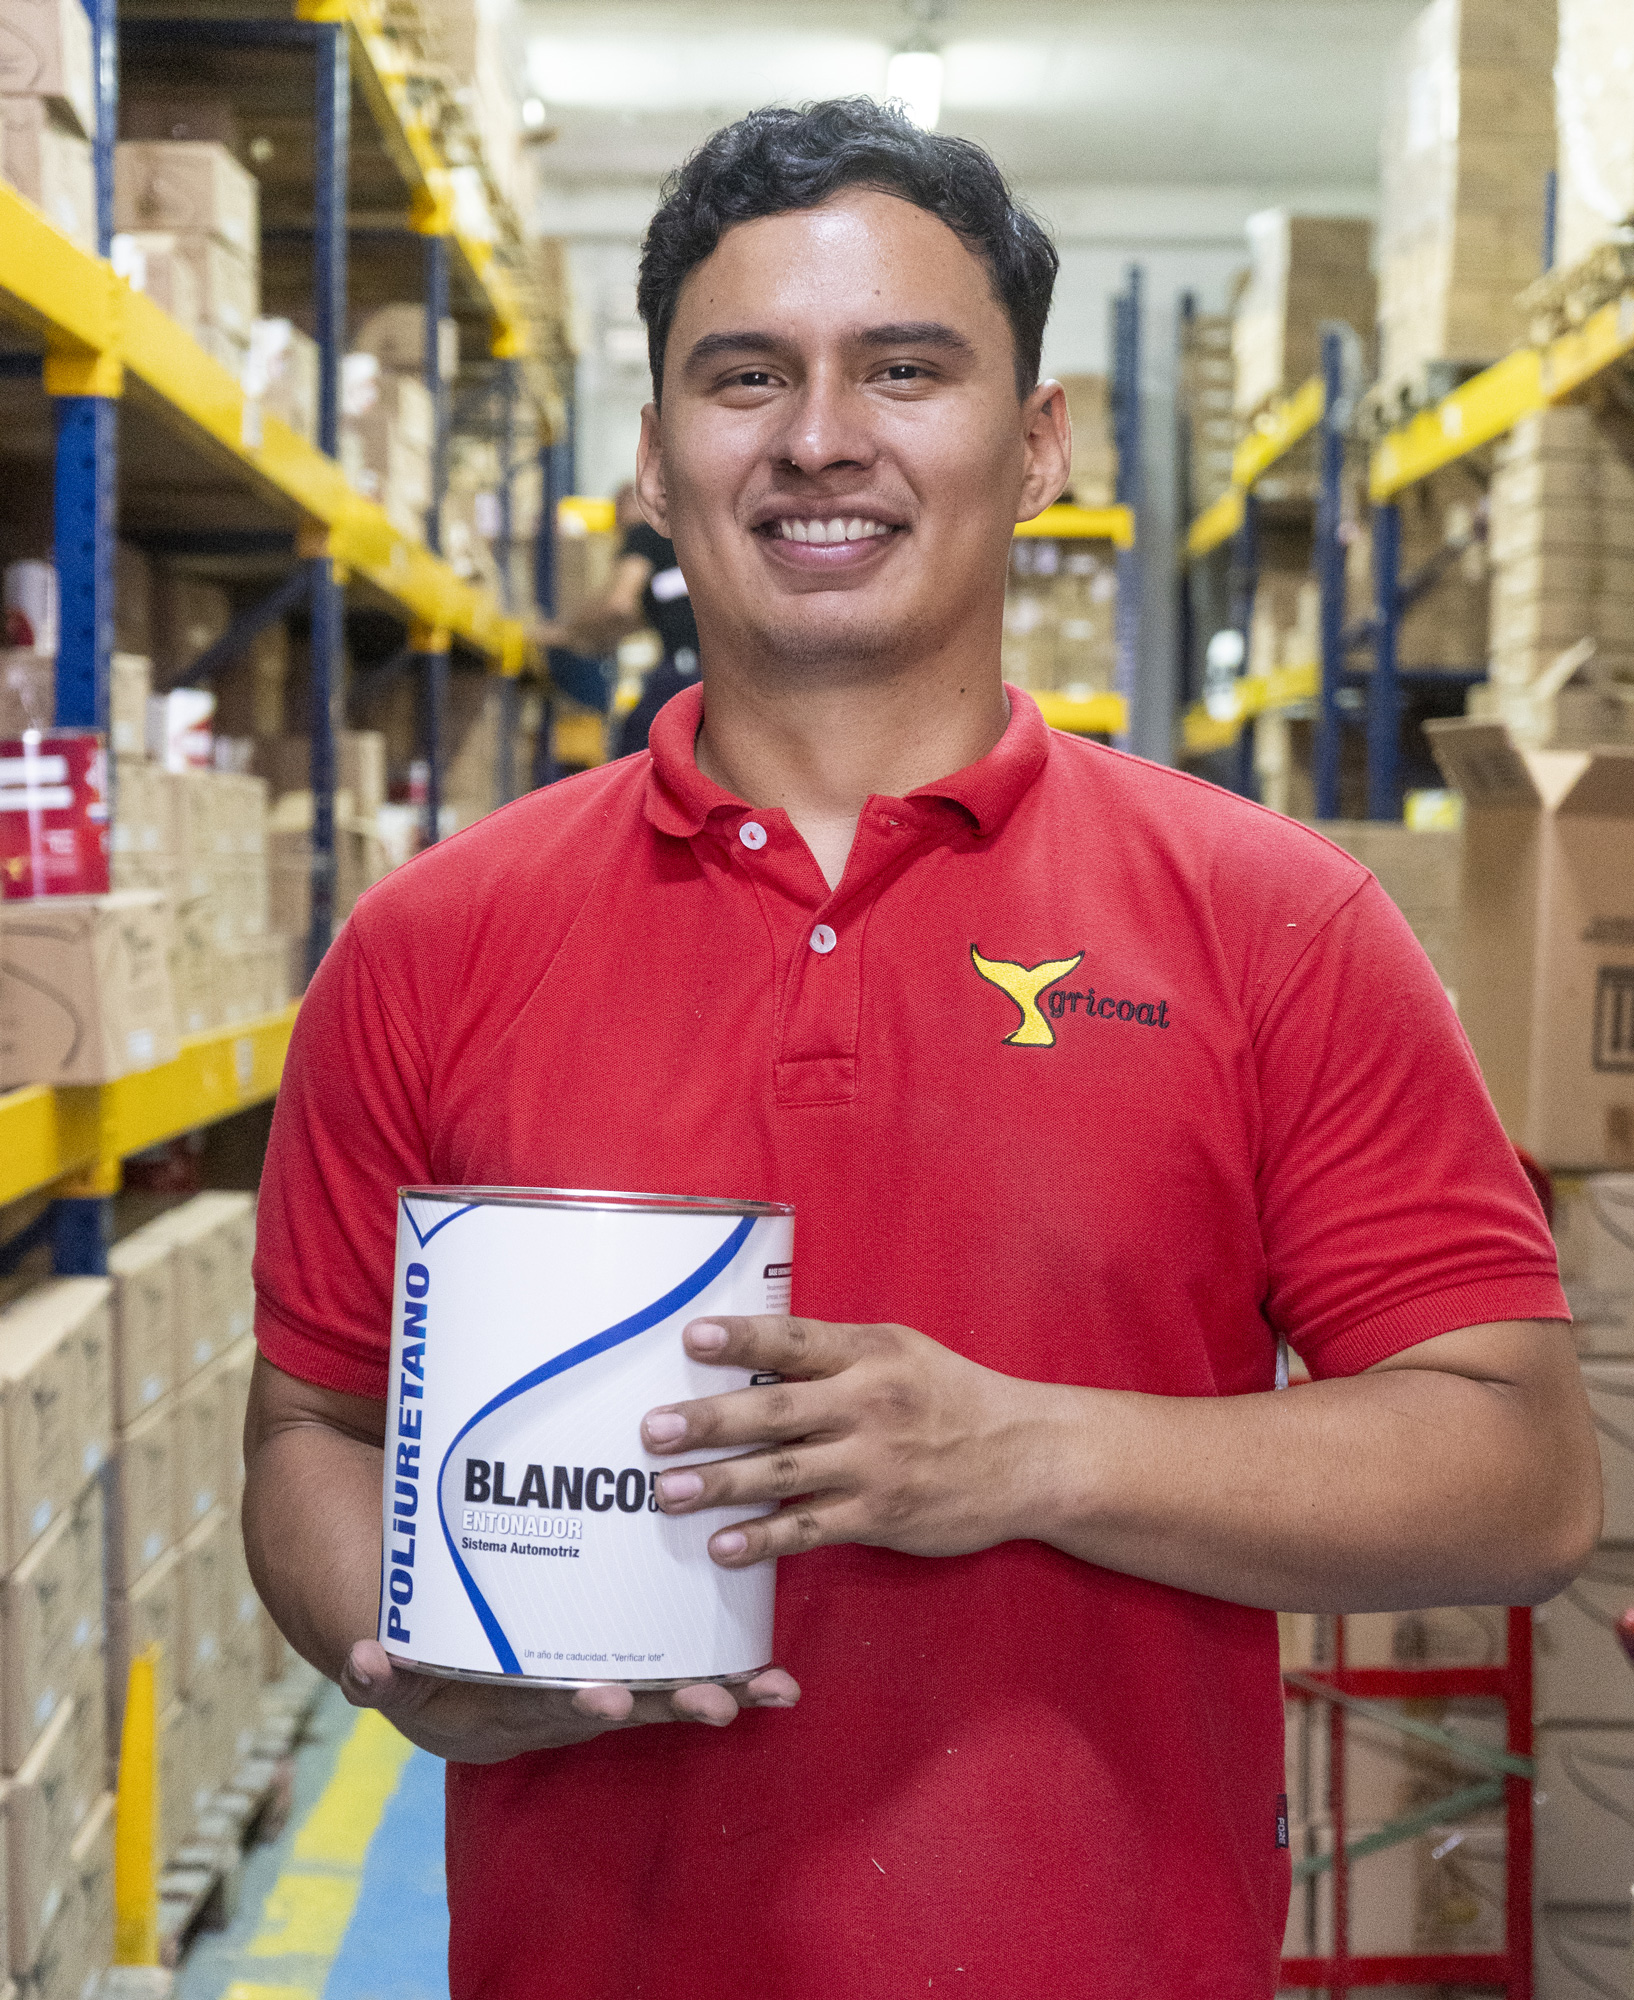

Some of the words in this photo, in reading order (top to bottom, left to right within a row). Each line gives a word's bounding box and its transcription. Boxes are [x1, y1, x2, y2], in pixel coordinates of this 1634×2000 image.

[1048, 987, 1170, 1029] gricoat
[464, 1458, 646, 1513] BLANCO
[462, 1510, 583, 1539] ENTONADOR
[461, 1537, 507, 1553] Sistema
[510, 1542, 580, 1558] Automotriz
[524, 1649, 535, 1658] Un
[537, 1650, 551, 1660] año
[553, 1651, 564, 1660] de
[565, 1653, 609, 1661] caducidad.
